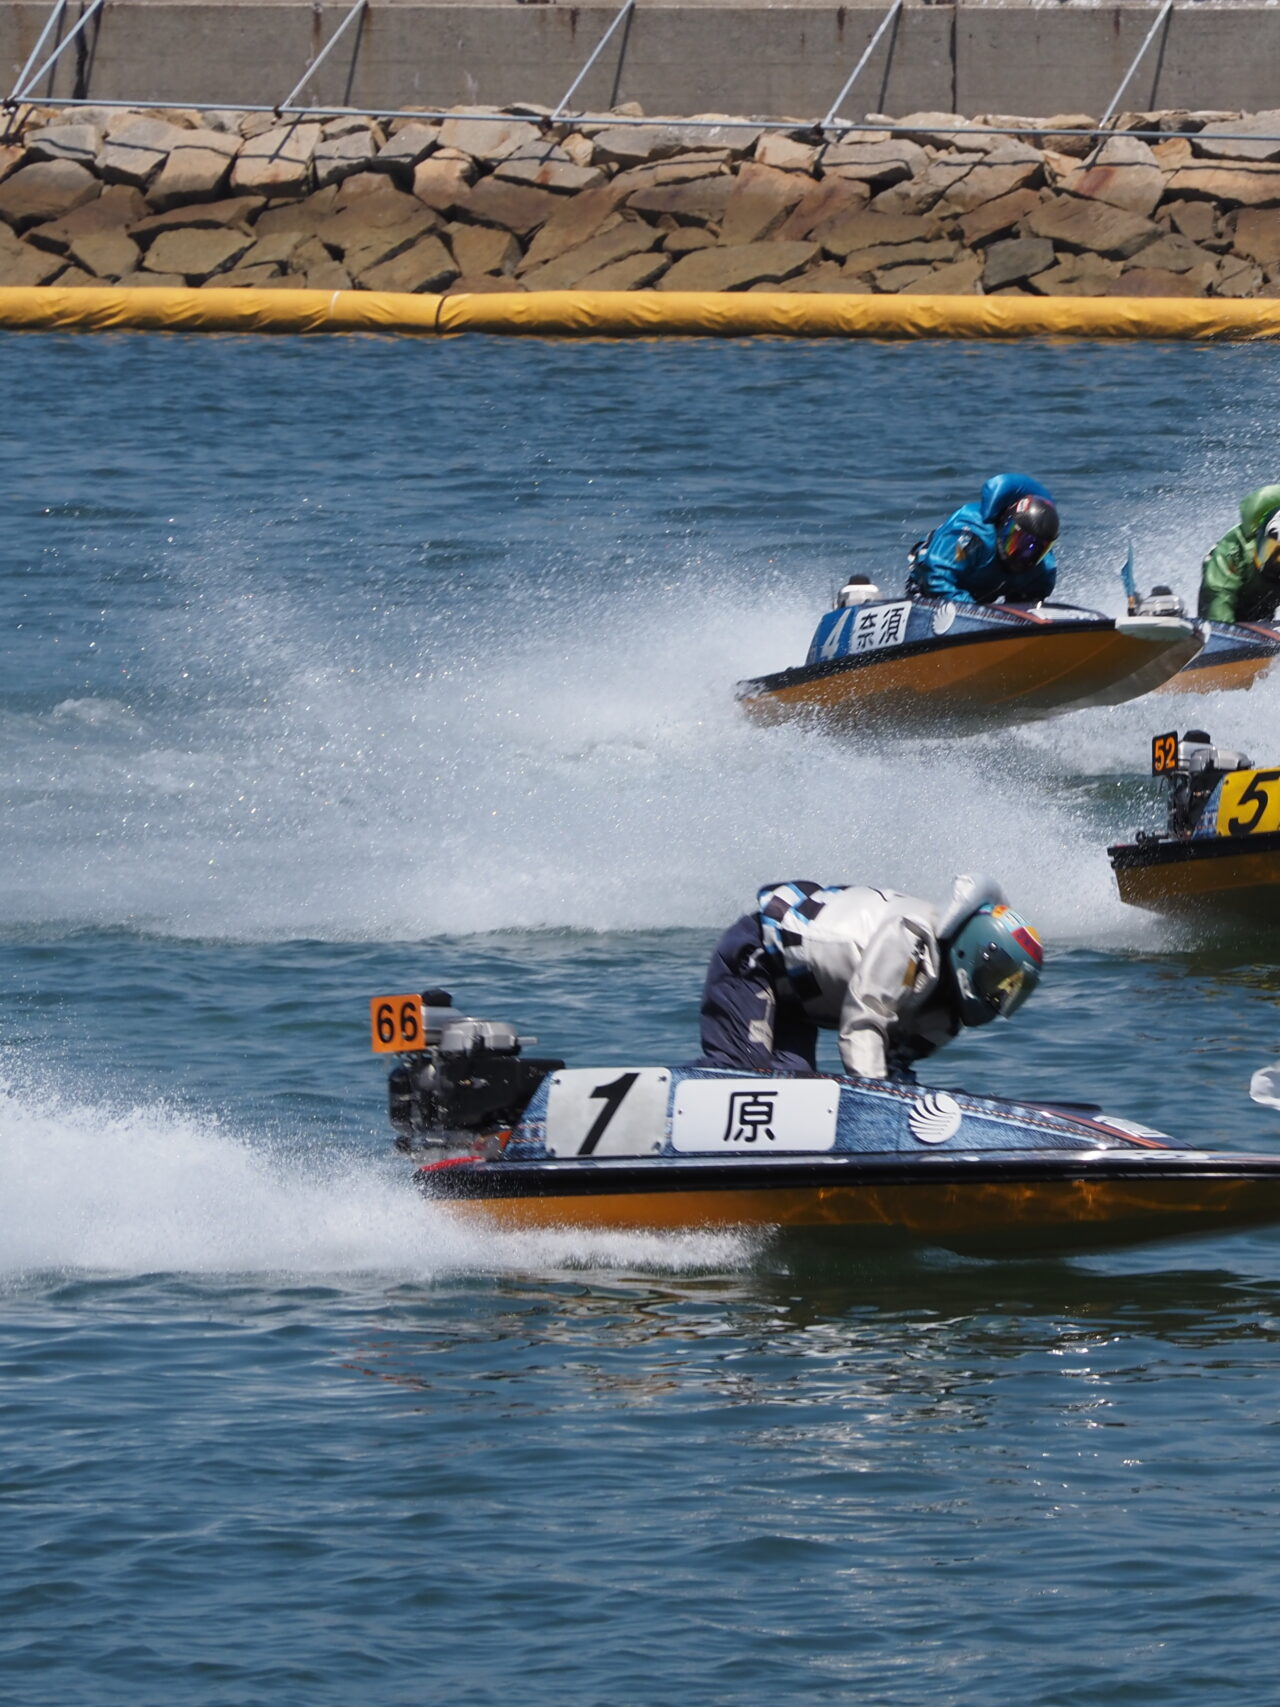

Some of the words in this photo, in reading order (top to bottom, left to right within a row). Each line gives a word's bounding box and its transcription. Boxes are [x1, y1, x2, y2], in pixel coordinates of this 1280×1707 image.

[820, 607, 853, 660] 4
[856, 606, 905, 650] 奈須
[1153, 736, 1176, 771] 52
[377, 1002, 418, 1043] 66
[576, 1072, 642, 1156] 1
[722, 1090, 779, 1143] 原
